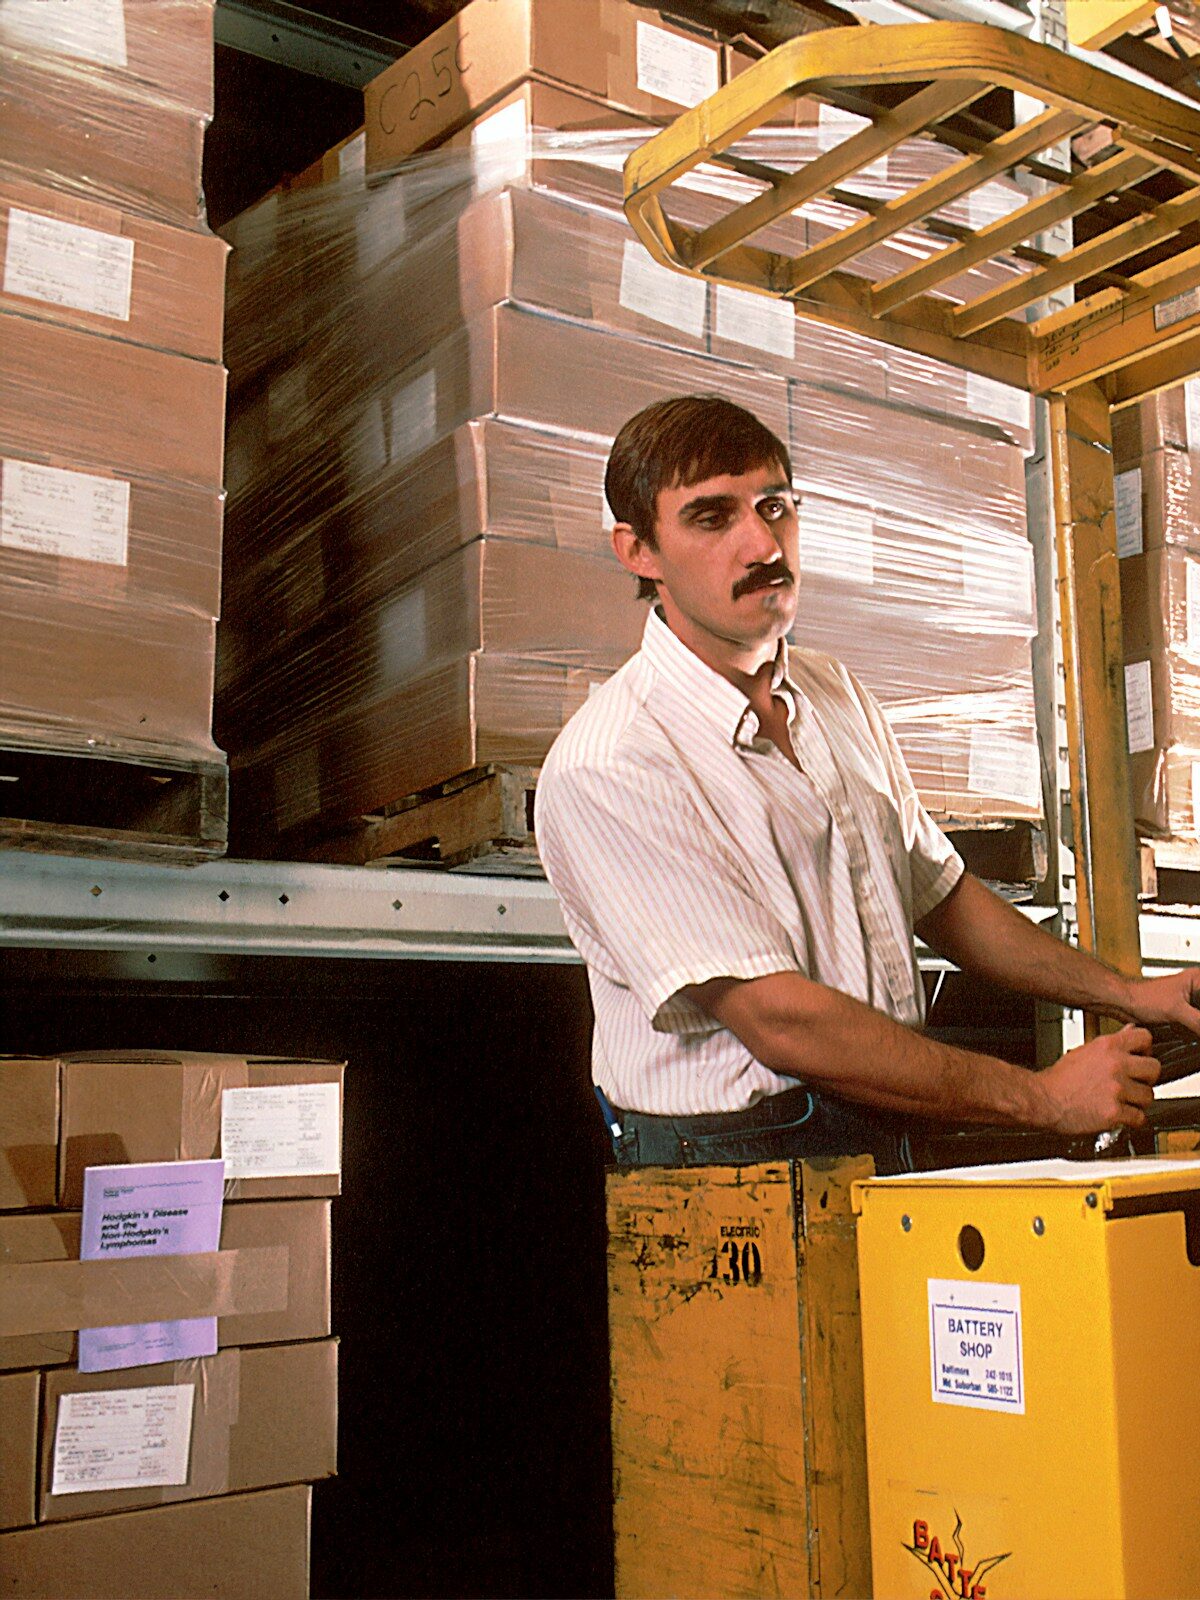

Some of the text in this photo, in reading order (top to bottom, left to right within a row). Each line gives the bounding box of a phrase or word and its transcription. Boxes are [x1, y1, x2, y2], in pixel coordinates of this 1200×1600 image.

[101, 1208, 189, 1223] Hodgkin's Disease
[101, 1221, 138, 1231] and the
[100, 1238, 158, 1251] Lymphomas
[948, 1318, 1003, 1338] BATTERY
[959, 1340, 993, 1359] SHOP
[942, 1363, 970, 1377] Baltimore
